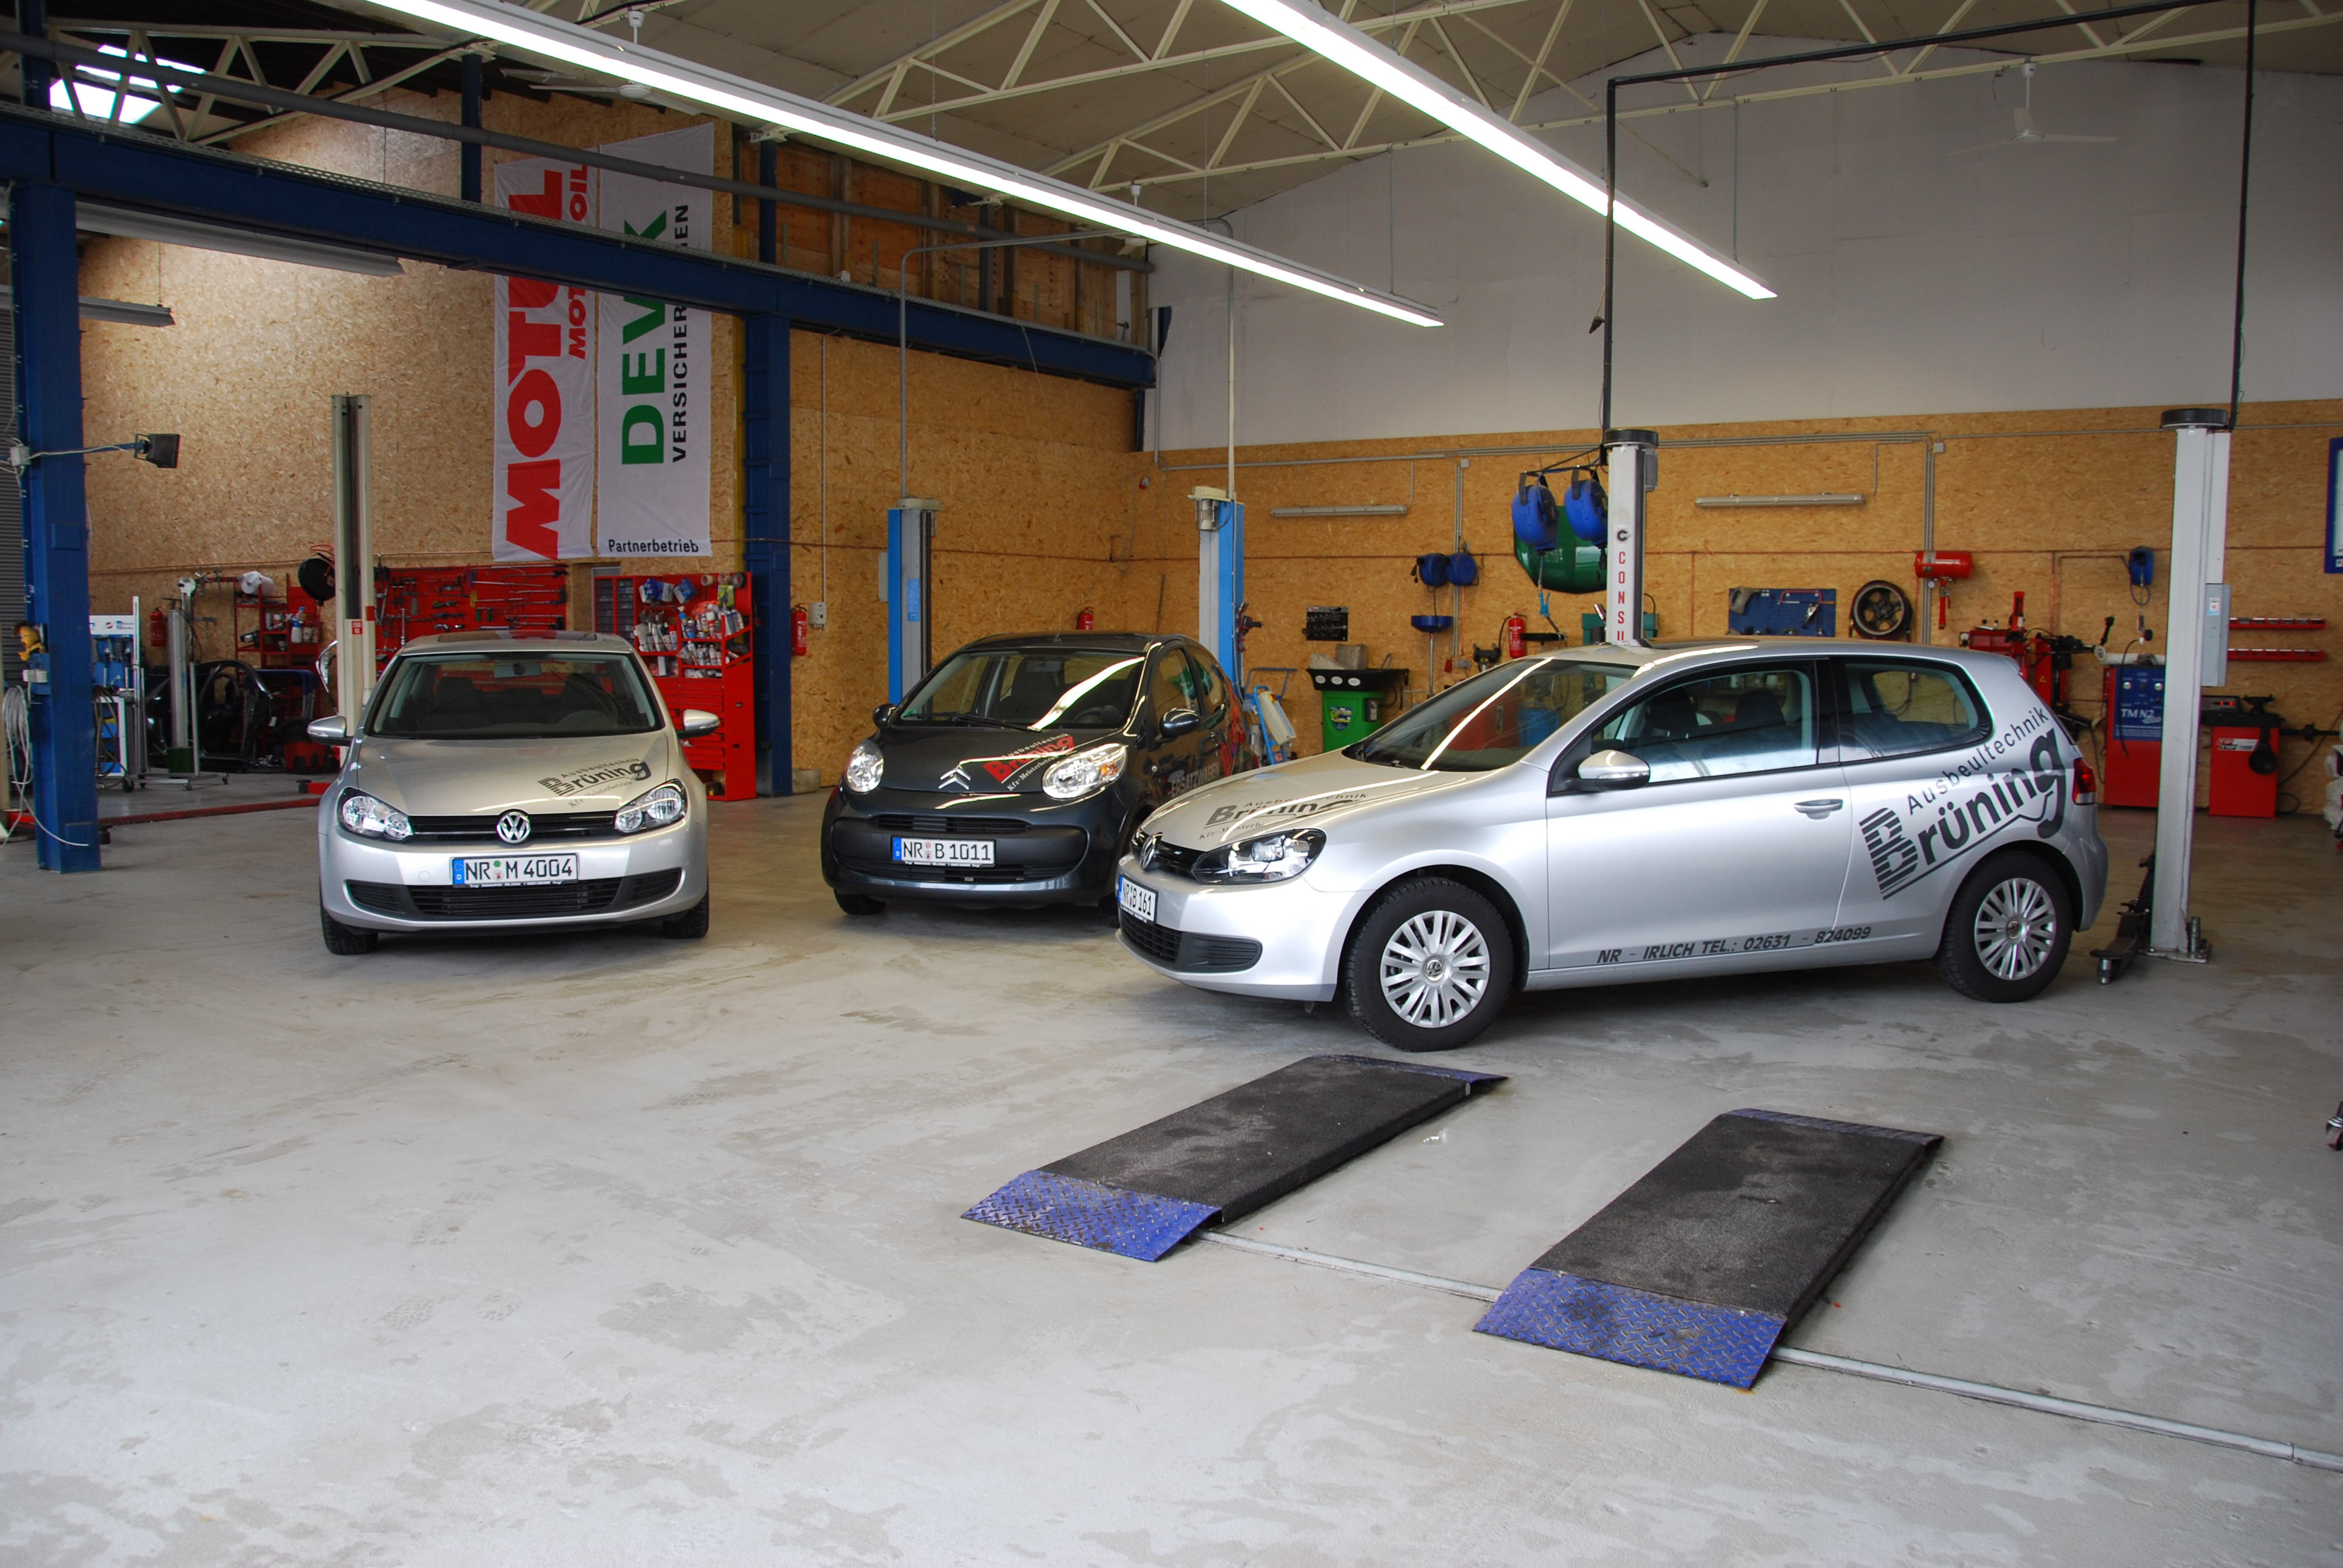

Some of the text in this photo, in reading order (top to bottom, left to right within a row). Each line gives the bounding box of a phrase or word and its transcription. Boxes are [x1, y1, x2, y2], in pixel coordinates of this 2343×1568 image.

[673, 204, 689, 463] VERSICHEREN
[608, 538, 699, 552] Partnerbetrieb
[561, 757, 640, 779] Ausbeultechnik
[1907, 706, 2050, 815] Ausbeultechnik
[538, 761, 652, 796] Brüning
[1859, 728, 2066, 895] Brüning
[903, 841, 991, 861] NR B 1011
[465, 858, 573, 881] NR M 4004
[1132, 887, 1137, 908] B
[1138, 890, 1152, 916] 161
[1597, 949, 1622, 964] NR
[1643, 942, 1696, 960] IRLICH
[1701, 939, 1737, 955] TEL.:
[1743, 933, 1791, 951] 02631
[1815, 926, 1872, 945] 824099
